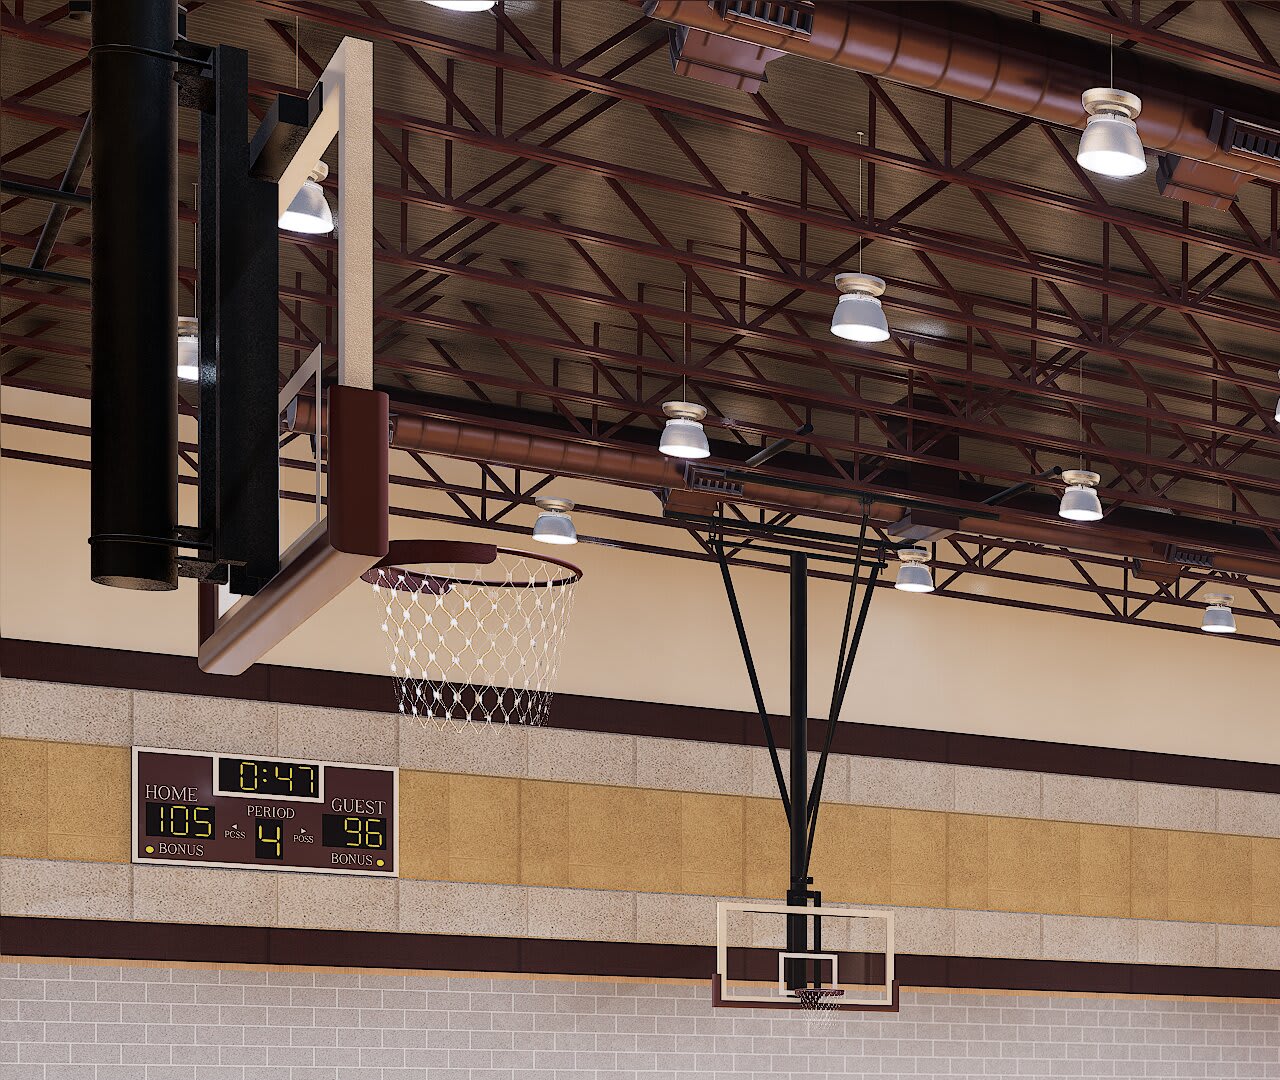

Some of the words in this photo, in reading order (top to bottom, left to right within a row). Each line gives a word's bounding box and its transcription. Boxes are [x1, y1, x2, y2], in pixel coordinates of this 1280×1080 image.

[239, 761, 314, 793] 0:47
[145, 784, 198, 802] HOME
[247, 805, 295, 819] PERIOD
[331, 798, 386, 815] GUEST
[160, 805, 212, 838] 105
[258, 824, 281, 857] 4
[293, 834, 314, 844] POSS
[344, 817, 382, 848] 96
[158, 842, 204, 857] BONUS
[331, 852, 373, 866] BONUS
